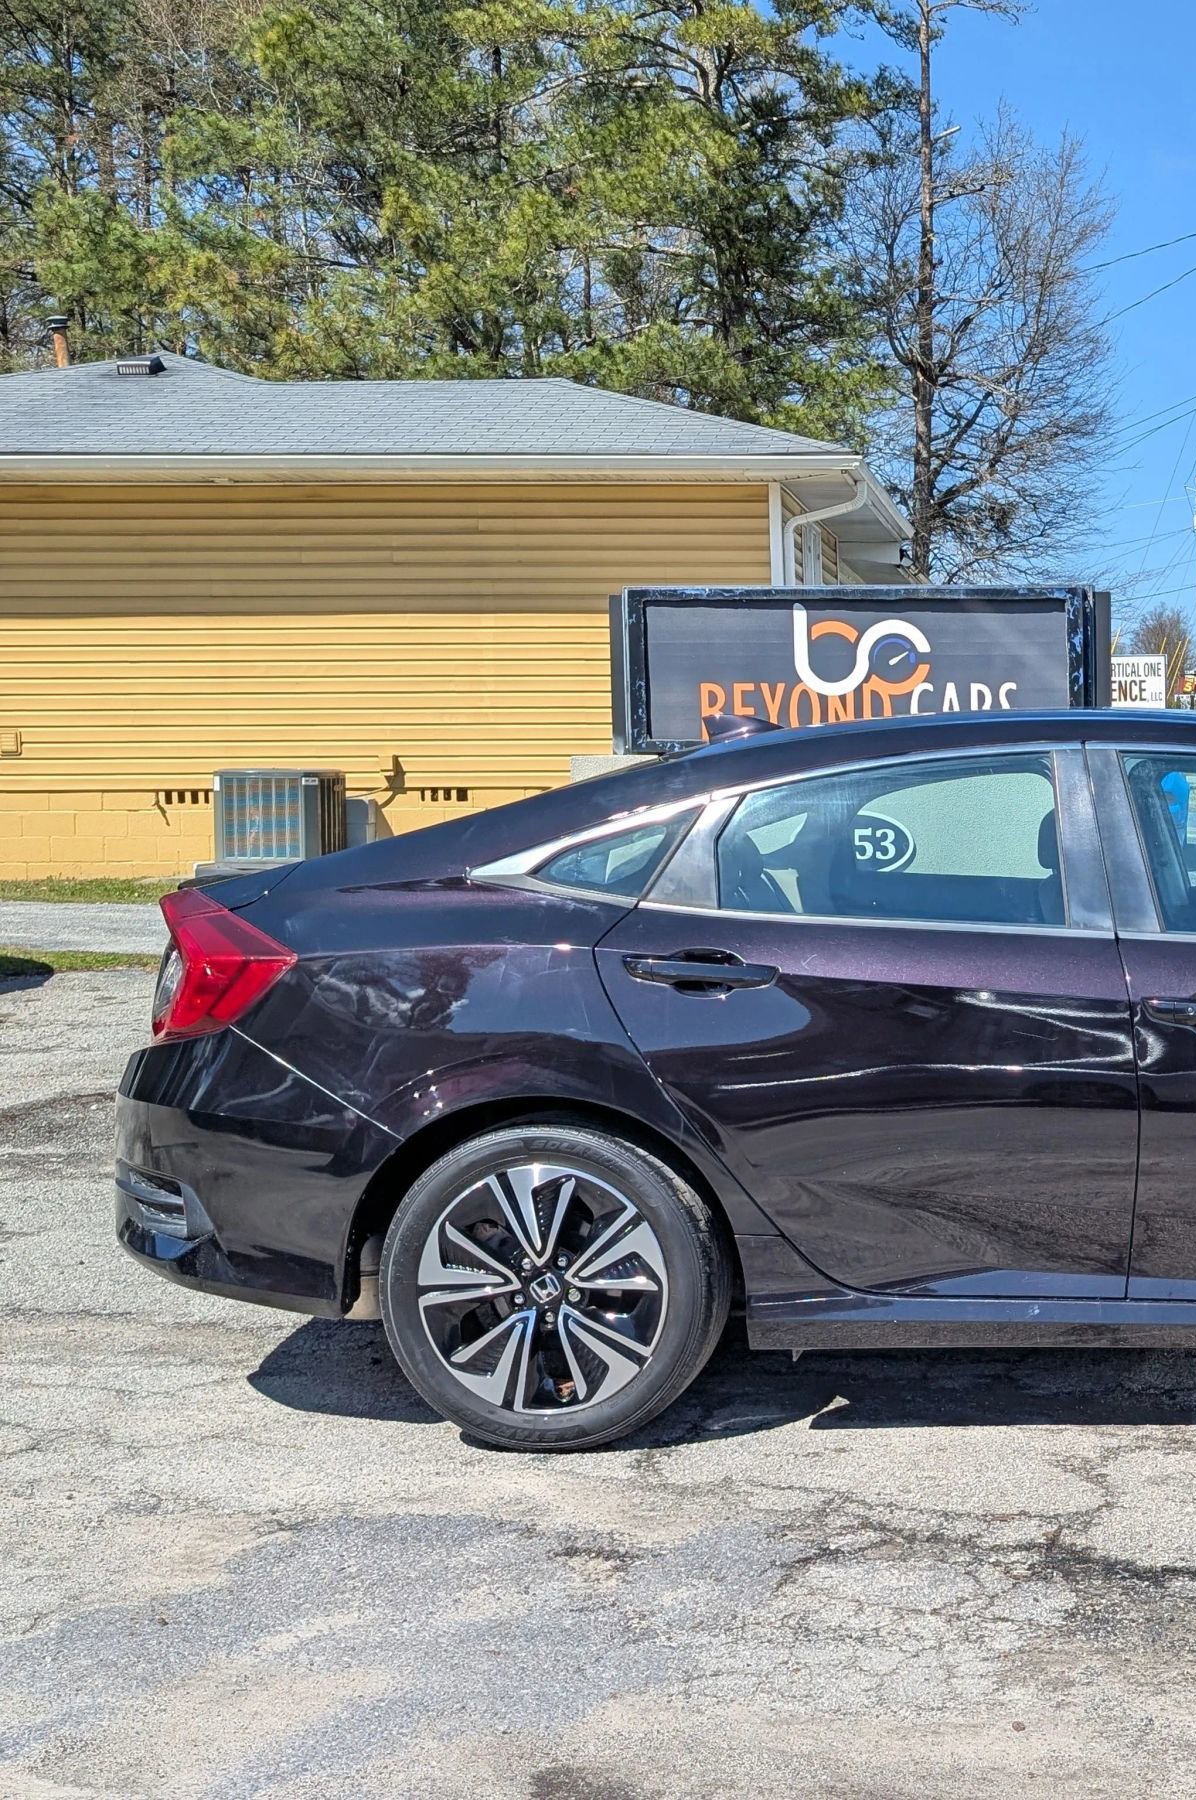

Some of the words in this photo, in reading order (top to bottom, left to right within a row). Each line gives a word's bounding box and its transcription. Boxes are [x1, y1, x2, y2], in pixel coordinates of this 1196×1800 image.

[1144, 662, 1161, 677] ONE
[1151, 692, 1162, 701] LLC
[854, 827, 896, 860] 53
